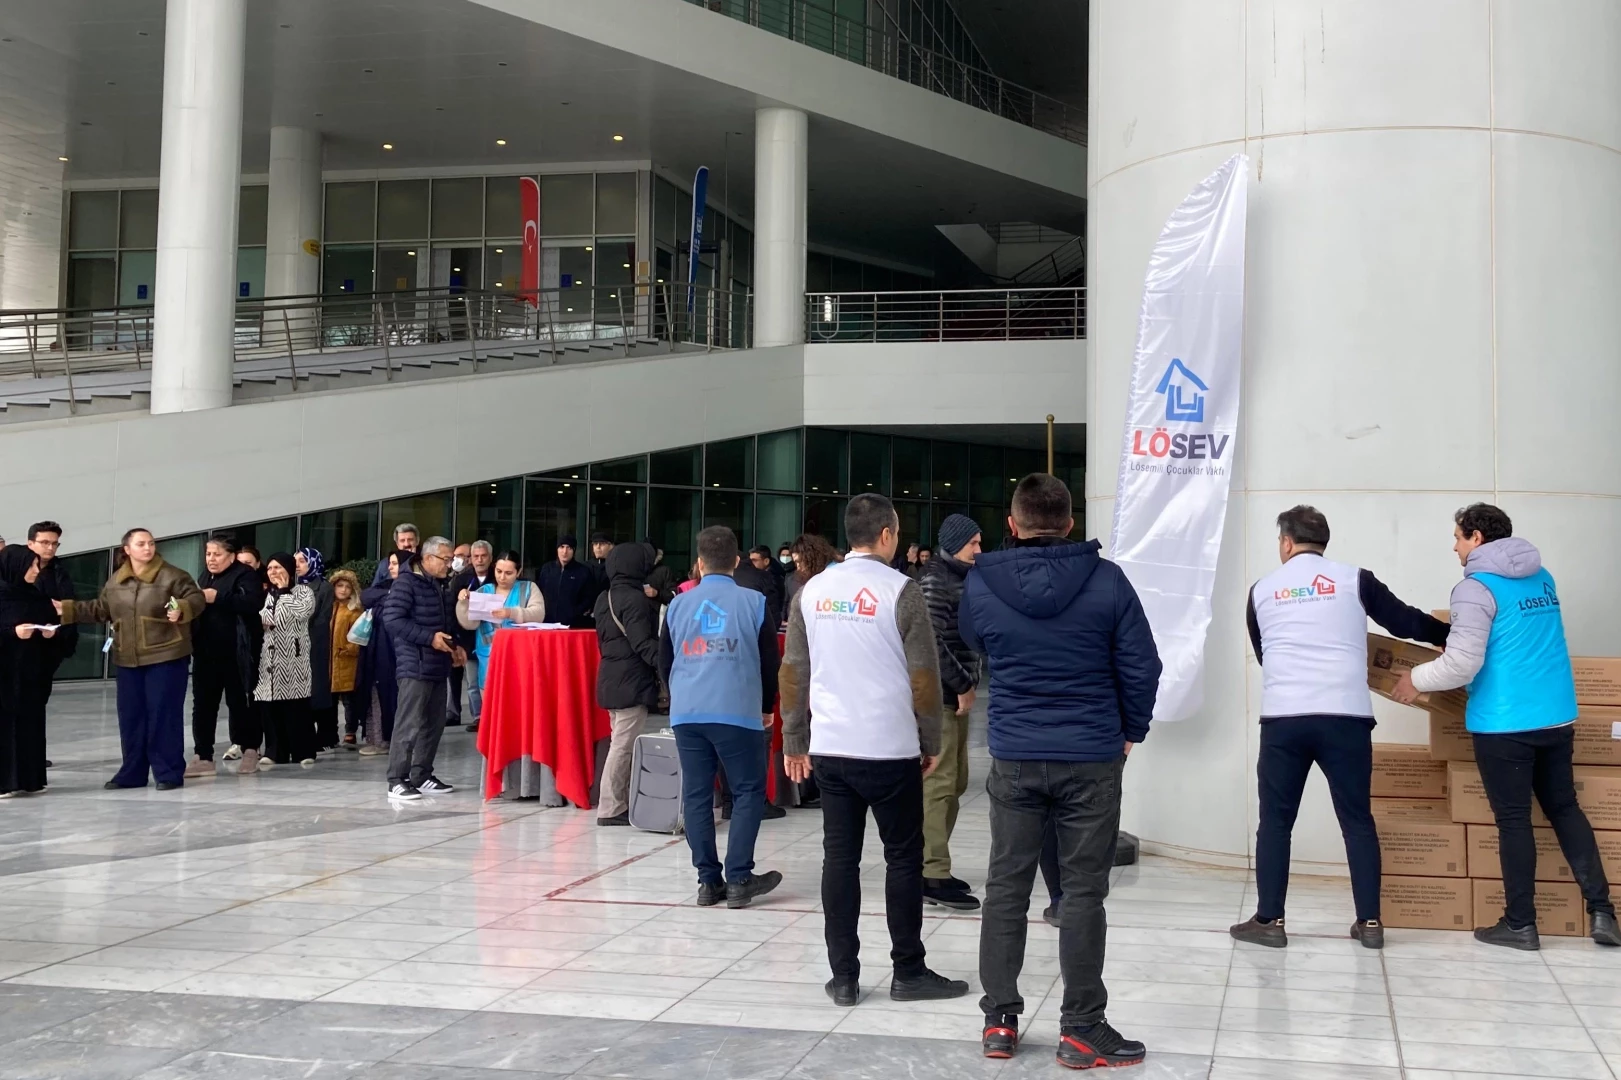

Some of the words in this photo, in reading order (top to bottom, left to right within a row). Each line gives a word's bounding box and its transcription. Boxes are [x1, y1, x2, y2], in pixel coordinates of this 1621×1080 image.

[1133, 427, 1230, 459] LÖSEV
[1130, 461, 1163, 473] Lösemili
[1166, 464, 1204, 475] Çocuklar
[1206, 466, 1225, 476] Vakfı
[1275, 586, 1315, 600] LÖSEV
[815, 597, 857, 613] LÖSEV
[1518, 596, 1550, 611] LÖSEV
